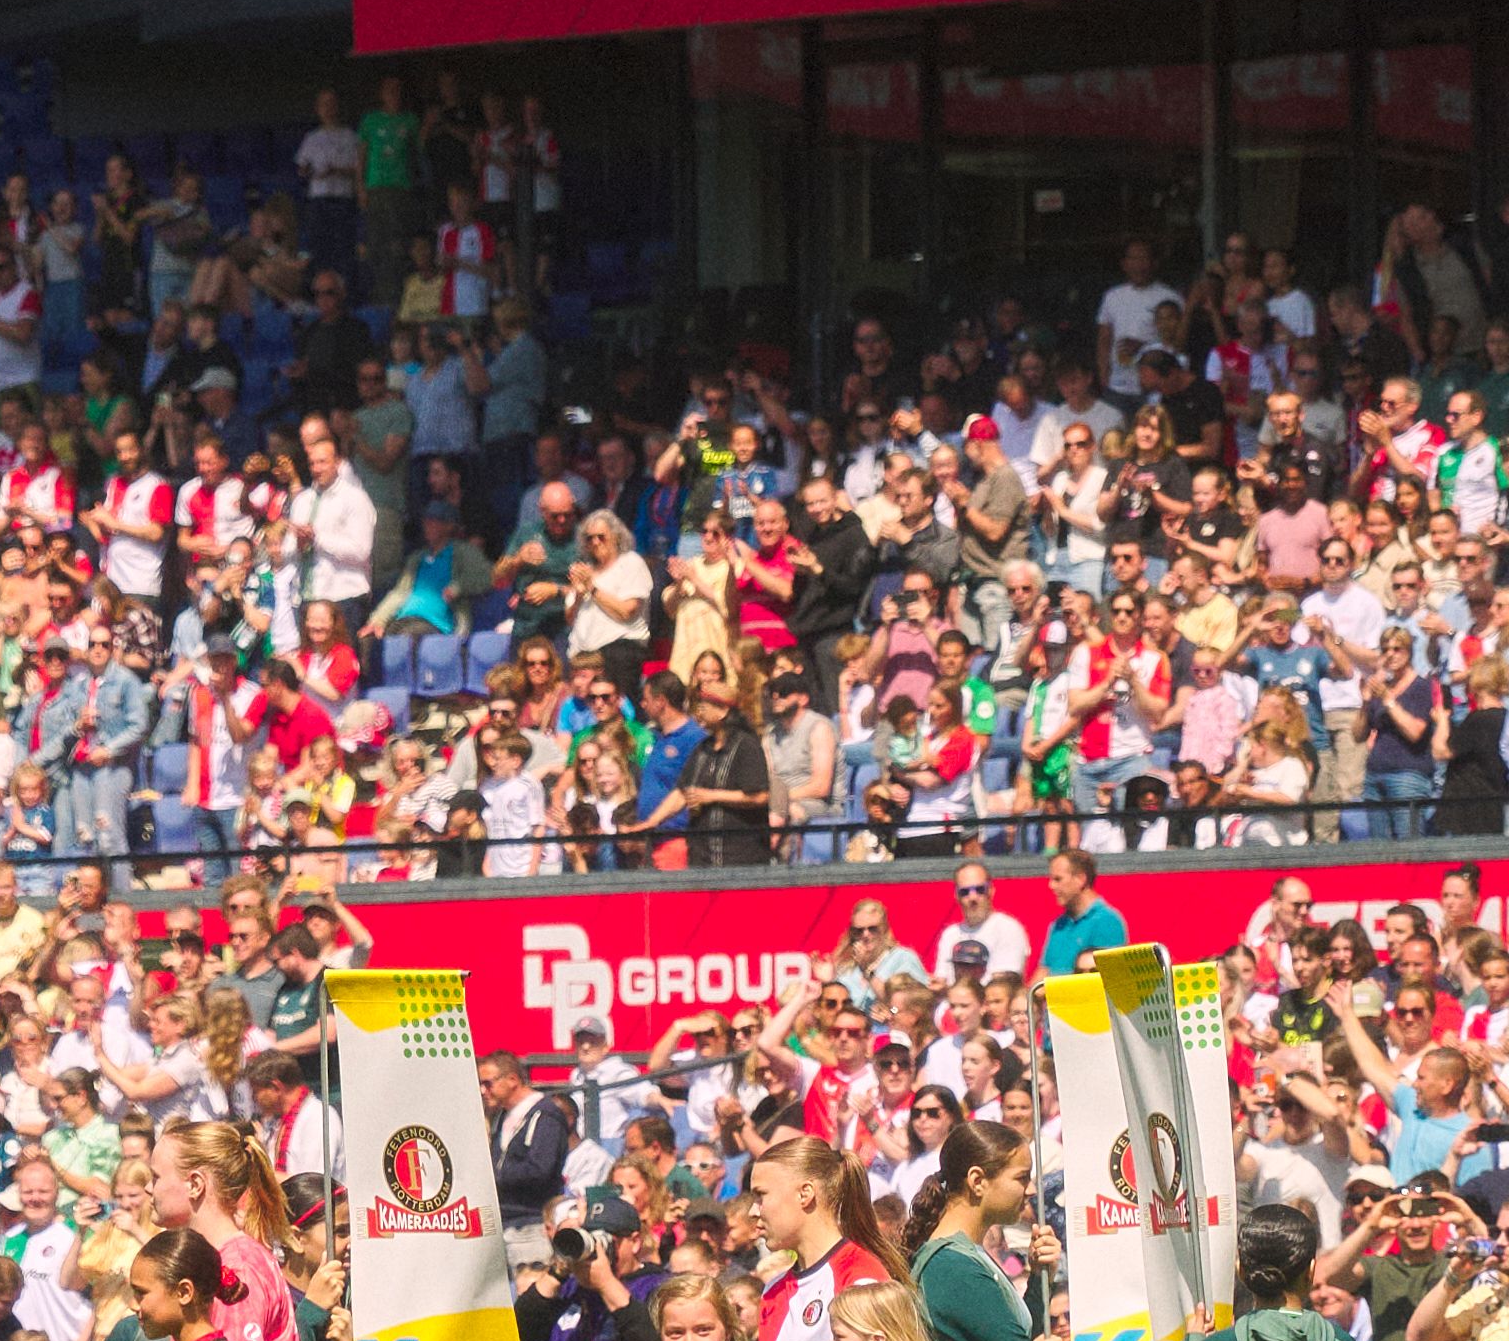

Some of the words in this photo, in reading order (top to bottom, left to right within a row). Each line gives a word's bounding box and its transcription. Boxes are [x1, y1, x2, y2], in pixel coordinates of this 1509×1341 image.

[618, 952, 813, 1006] GROUP
[386, 1125, 448, 1158] FEYENOORD
[389, 1180, 451, 1214] ROTTERDAM
[378, 1201, 468, 1232] KAMERAADJES
